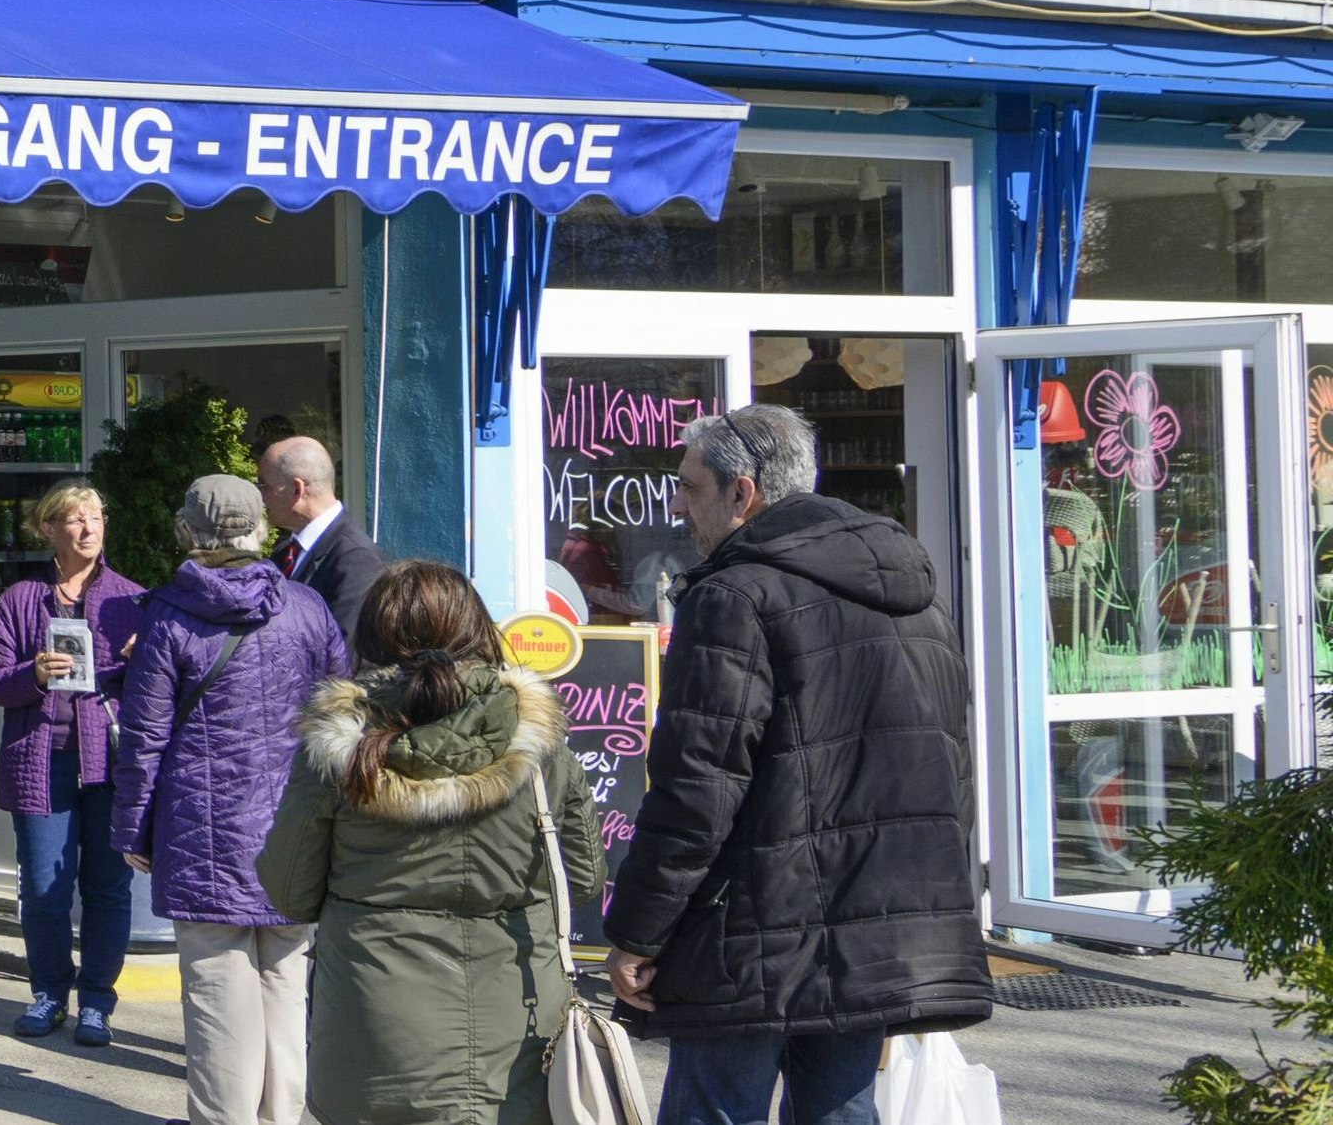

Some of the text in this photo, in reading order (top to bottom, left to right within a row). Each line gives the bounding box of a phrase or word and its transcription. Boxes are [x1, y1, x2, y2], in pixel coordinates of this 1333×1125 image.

[244, 113, 622, 185] ENTRANCE
[53, 385, 80, 397] RAUCH
[510, 632, 567, 653] Murauer
[555, 682, 648, 725] DINIZ
